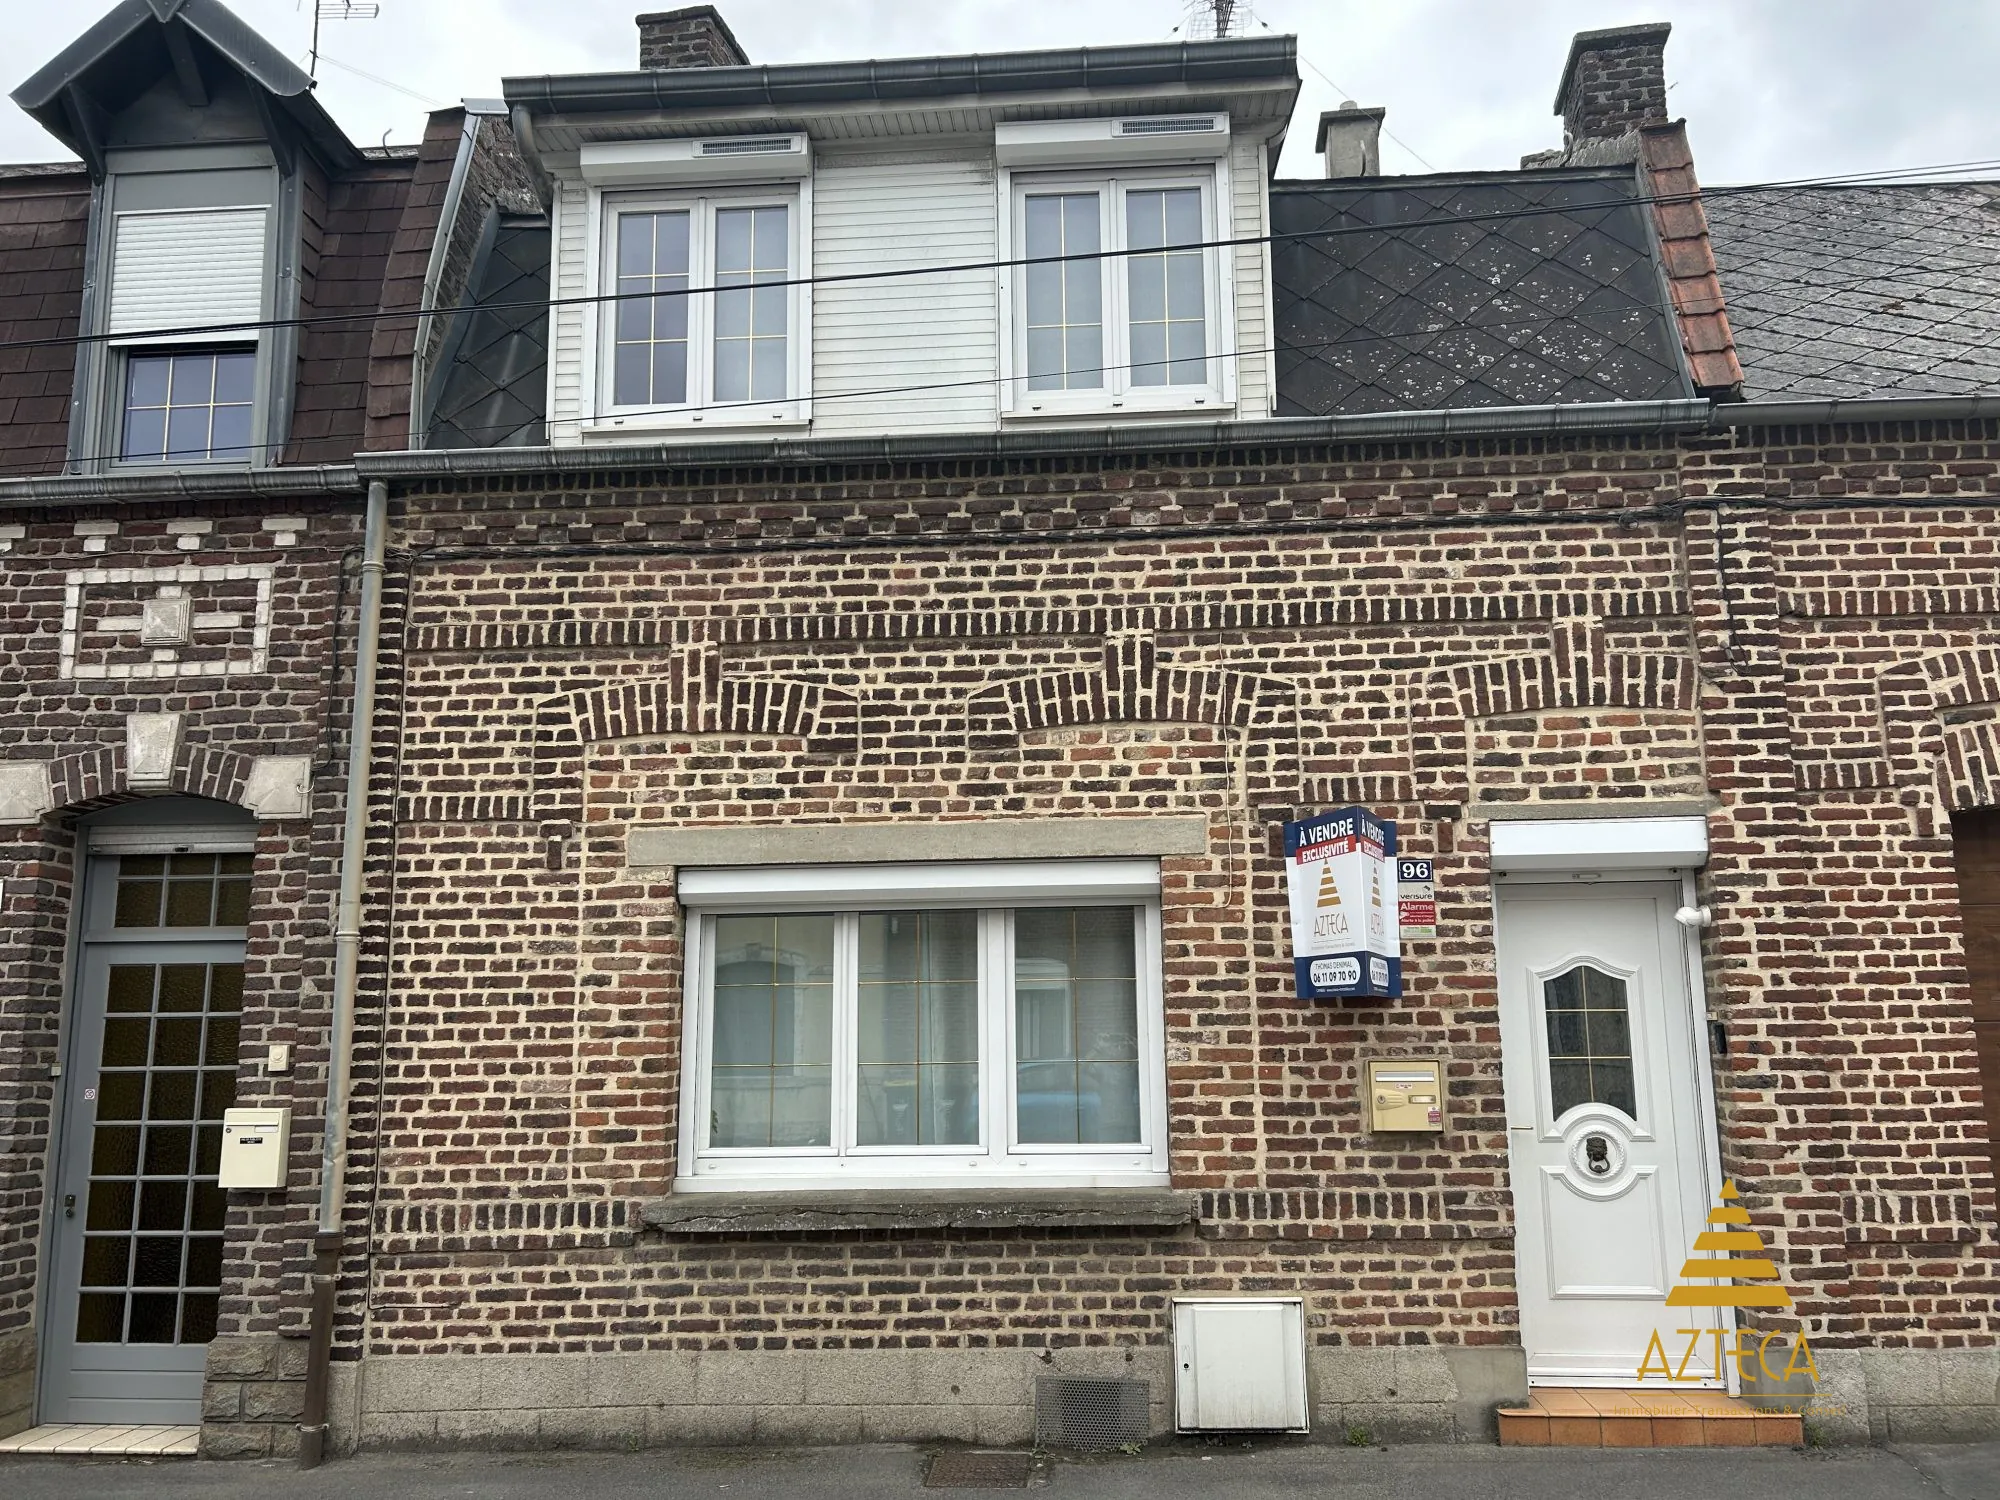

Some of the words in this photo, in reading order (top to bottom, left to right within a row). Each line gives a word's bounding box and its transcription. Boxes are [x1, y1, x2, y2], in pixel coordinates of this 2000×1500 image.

[1299, 827, 1307, 847] À
[1308, 818, 1354, 844] VENDRE
[1366, 821, 1385, 846] VENDRE
[1302, 837, 1349, 863] EXCLUSIVITÉ
[1402, 862, 1429, 878] 96
[1400, 902, 1434, 911] Alarme
[1313, 912, 1349, 937] AZTECA
[1315, 962, 1333, 970] THOMAS
[1313, 973, 1321, 983] 06
[1321, 973, 1328, 982] 11
[1329, 972, 1337, 982] 09
[1338, 971, 1347, 981] 70
[1347, 970, 1357, 980] 90
